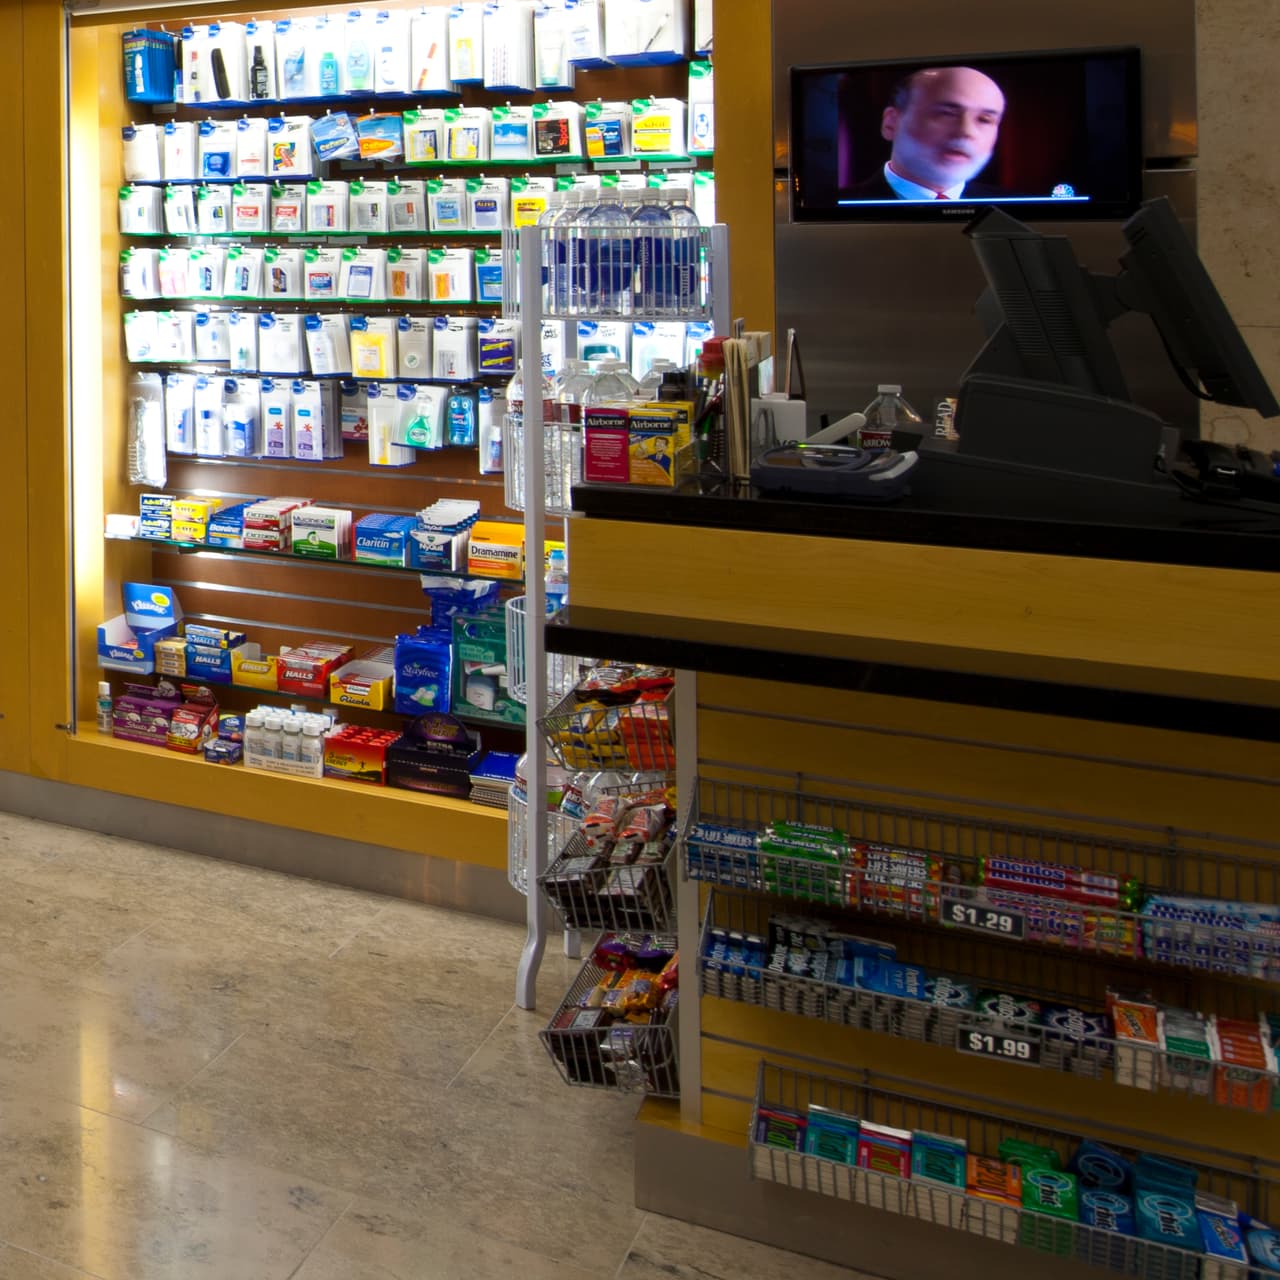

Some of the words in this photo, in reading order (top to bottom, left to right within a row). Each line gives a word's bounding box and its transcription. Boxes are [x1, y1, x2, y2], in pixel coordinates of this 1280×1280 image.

[587, 417, 625, 427] Airborne
[631, 420, 672, 430] Airborne
[935, 402, 954, 437] READ
[357, 536, 390, 549] Claritin
[419, 543, 444, 552] NyQuil
[471, 545, 518, 558] Dramamine
[131, 600, 167, 615] Kleenex
[193, 636, 217, 647] HALLS
[195, 655, 222, 665] HALLS
[241, 663, 270, 672] HALLS
[403, 664, 439, 678] Stayfree
[285, 670, 314, 680] HALLS
[339, 696, 371, 707] Ricola
[989, 858, 1065, 880] mentos
[952, 904, 1012, 932] $1.29
[968, 1032, 1031, 1060] $1.99
[1026, 1168, 1072, 1208] Orbit
[1082, 1190, 1129, 1231] Orbit
[1143, 1193, 1193, 1237] Orbit
